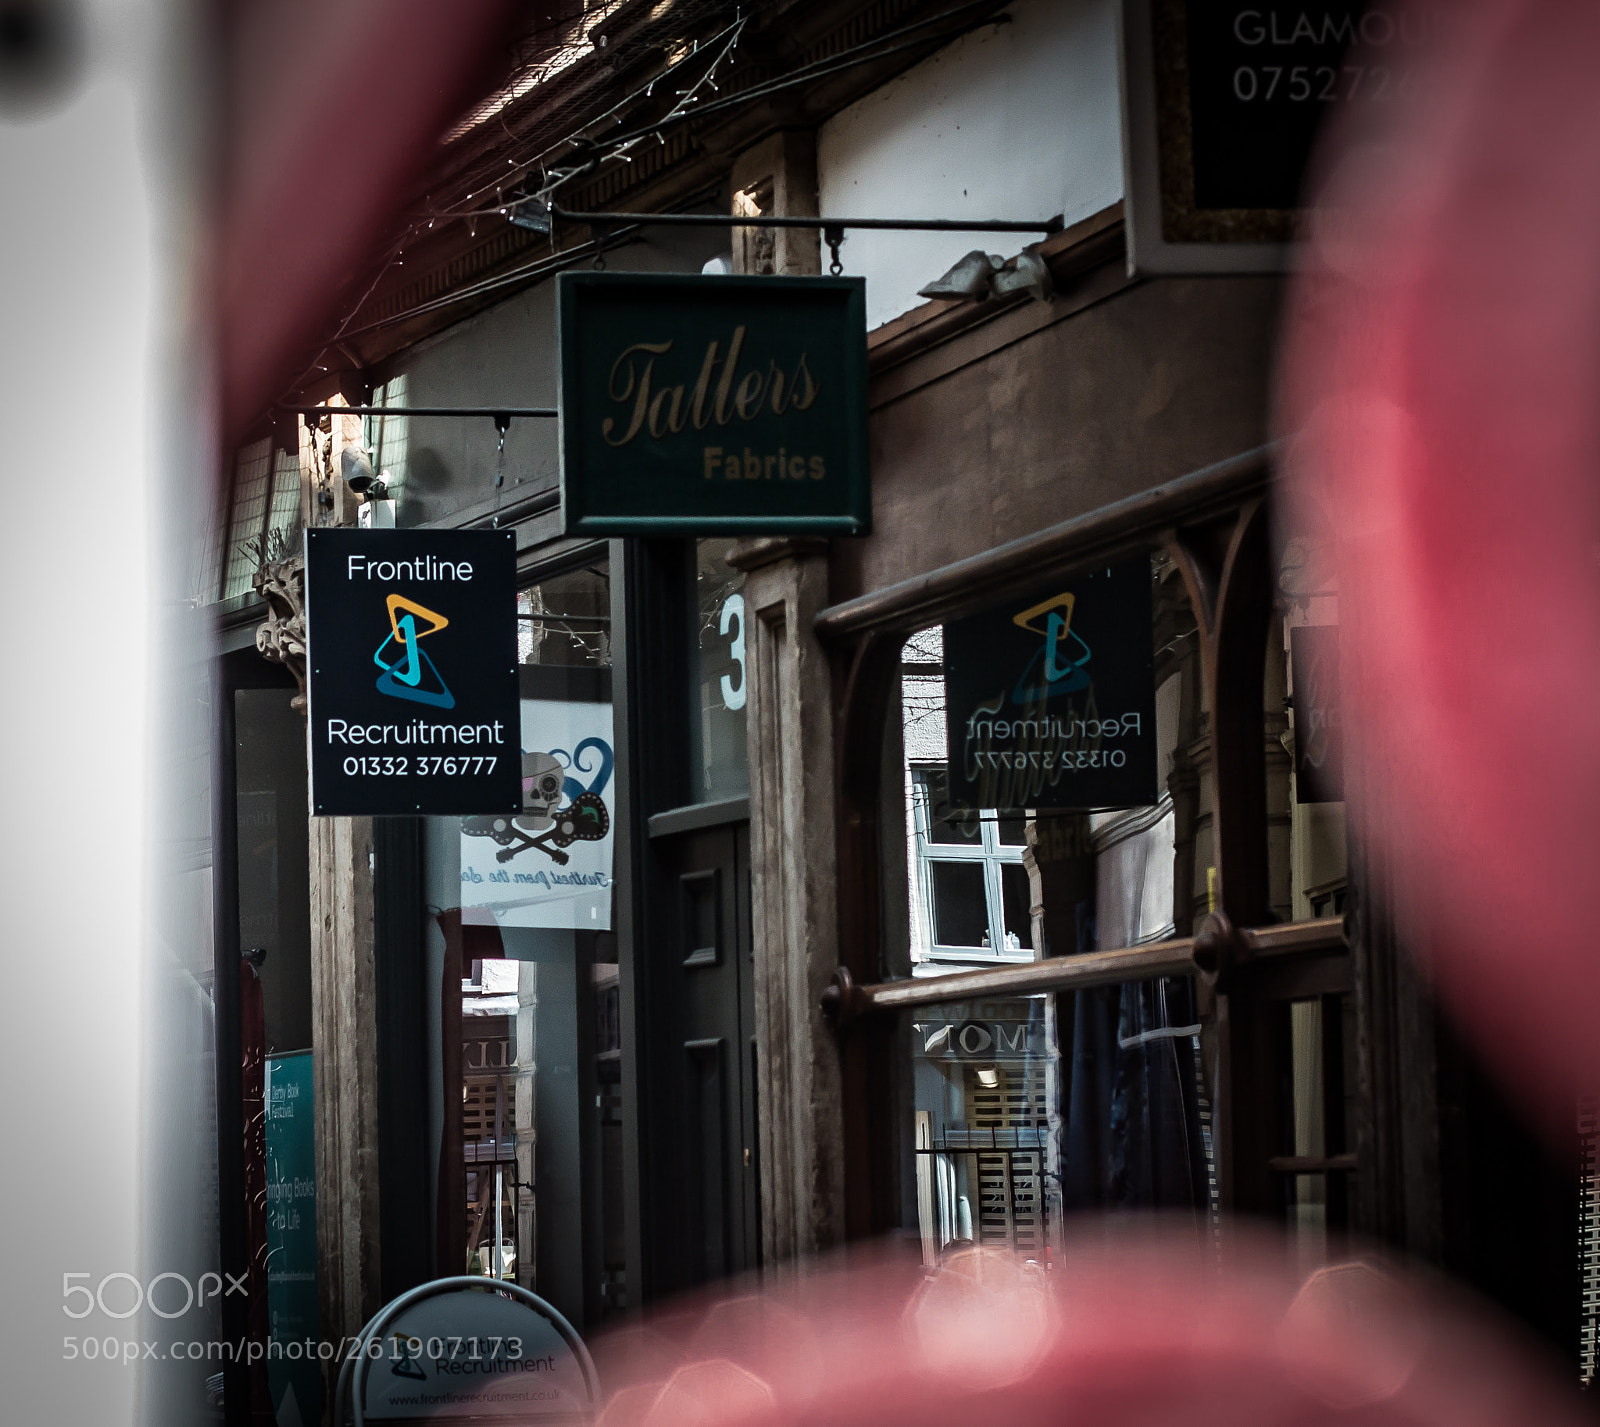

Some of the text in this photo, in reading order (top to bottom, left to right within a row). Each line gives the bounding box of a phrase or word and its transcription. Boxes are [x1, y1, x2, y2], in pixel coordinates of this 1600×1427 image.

[1232, 8, 1449, 47] GLAMOU
[602, 324, 822, 447] Tatlers
[703, 446, 826, 480] Fabrics
[347, 554, 474, 582] Frontline
[327, 718, 505, 745] Recruitment
[342, 756, 498, 776] 01332 376777
[435, 1355, 557, 1376] Recruitment
